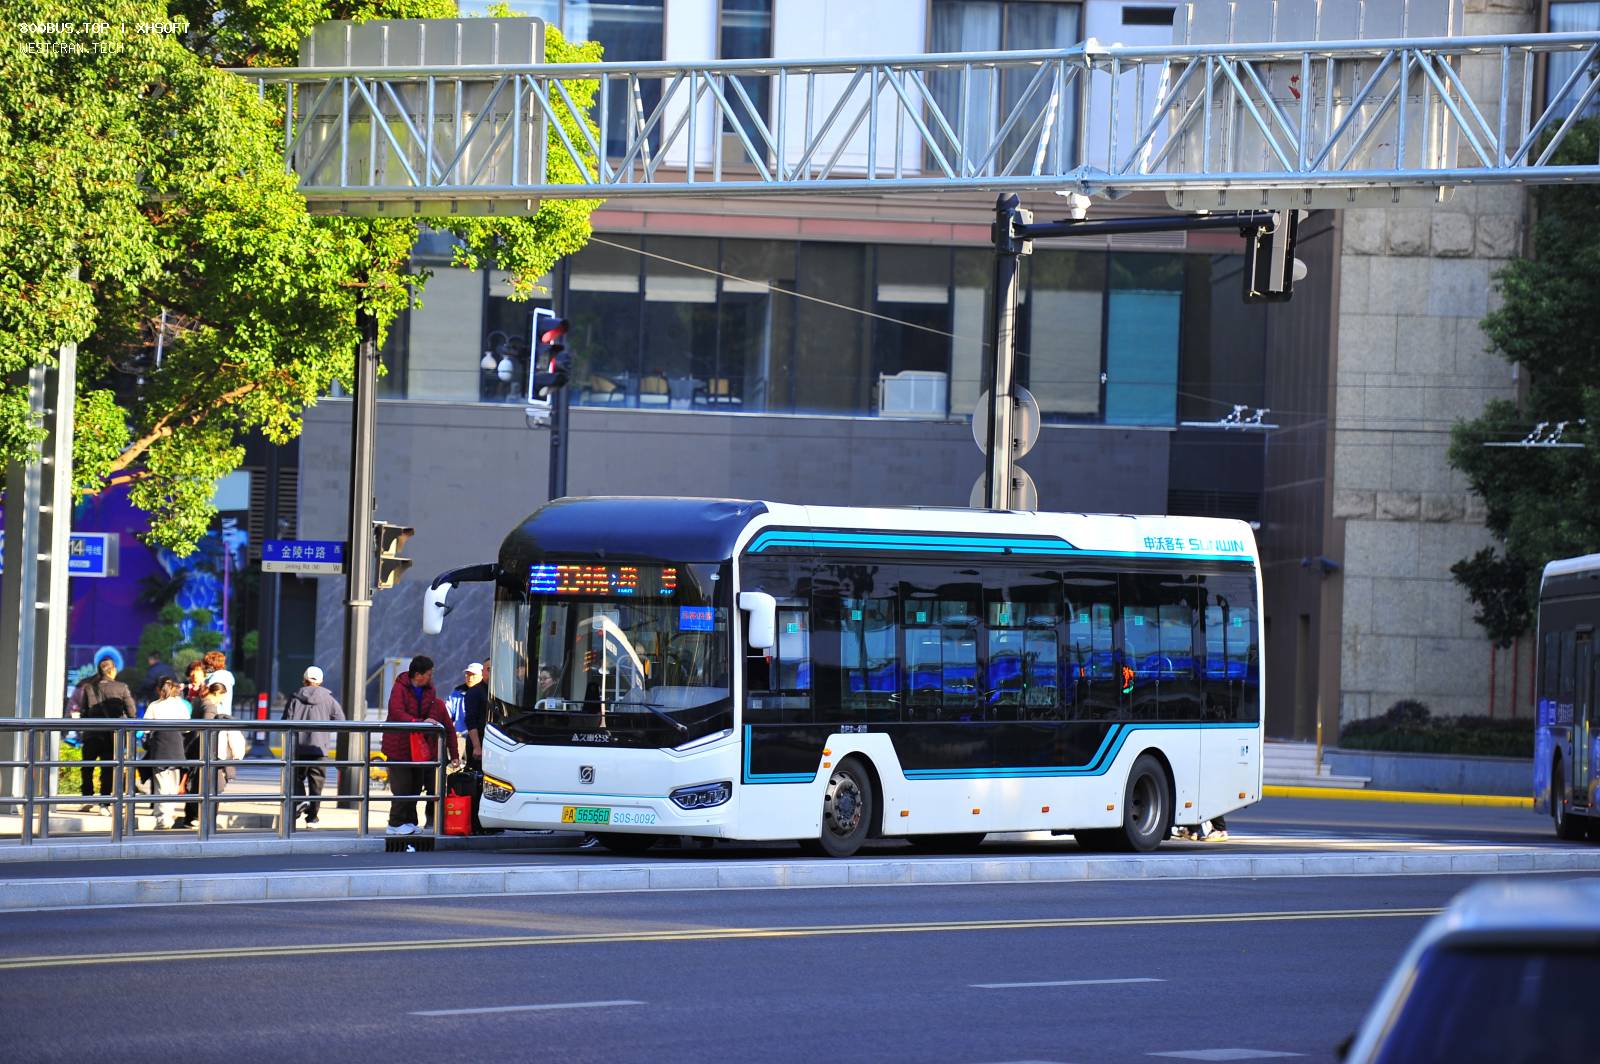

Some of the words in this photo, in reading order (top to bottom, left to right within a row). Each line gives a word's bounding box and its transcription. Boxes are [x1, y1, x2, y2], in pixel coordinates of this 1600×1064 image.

[1143, 536, 1186, 551] 申沃客车
[281, 545, 326, 559] 金陵中路
[333, 563, 340, 572] W
